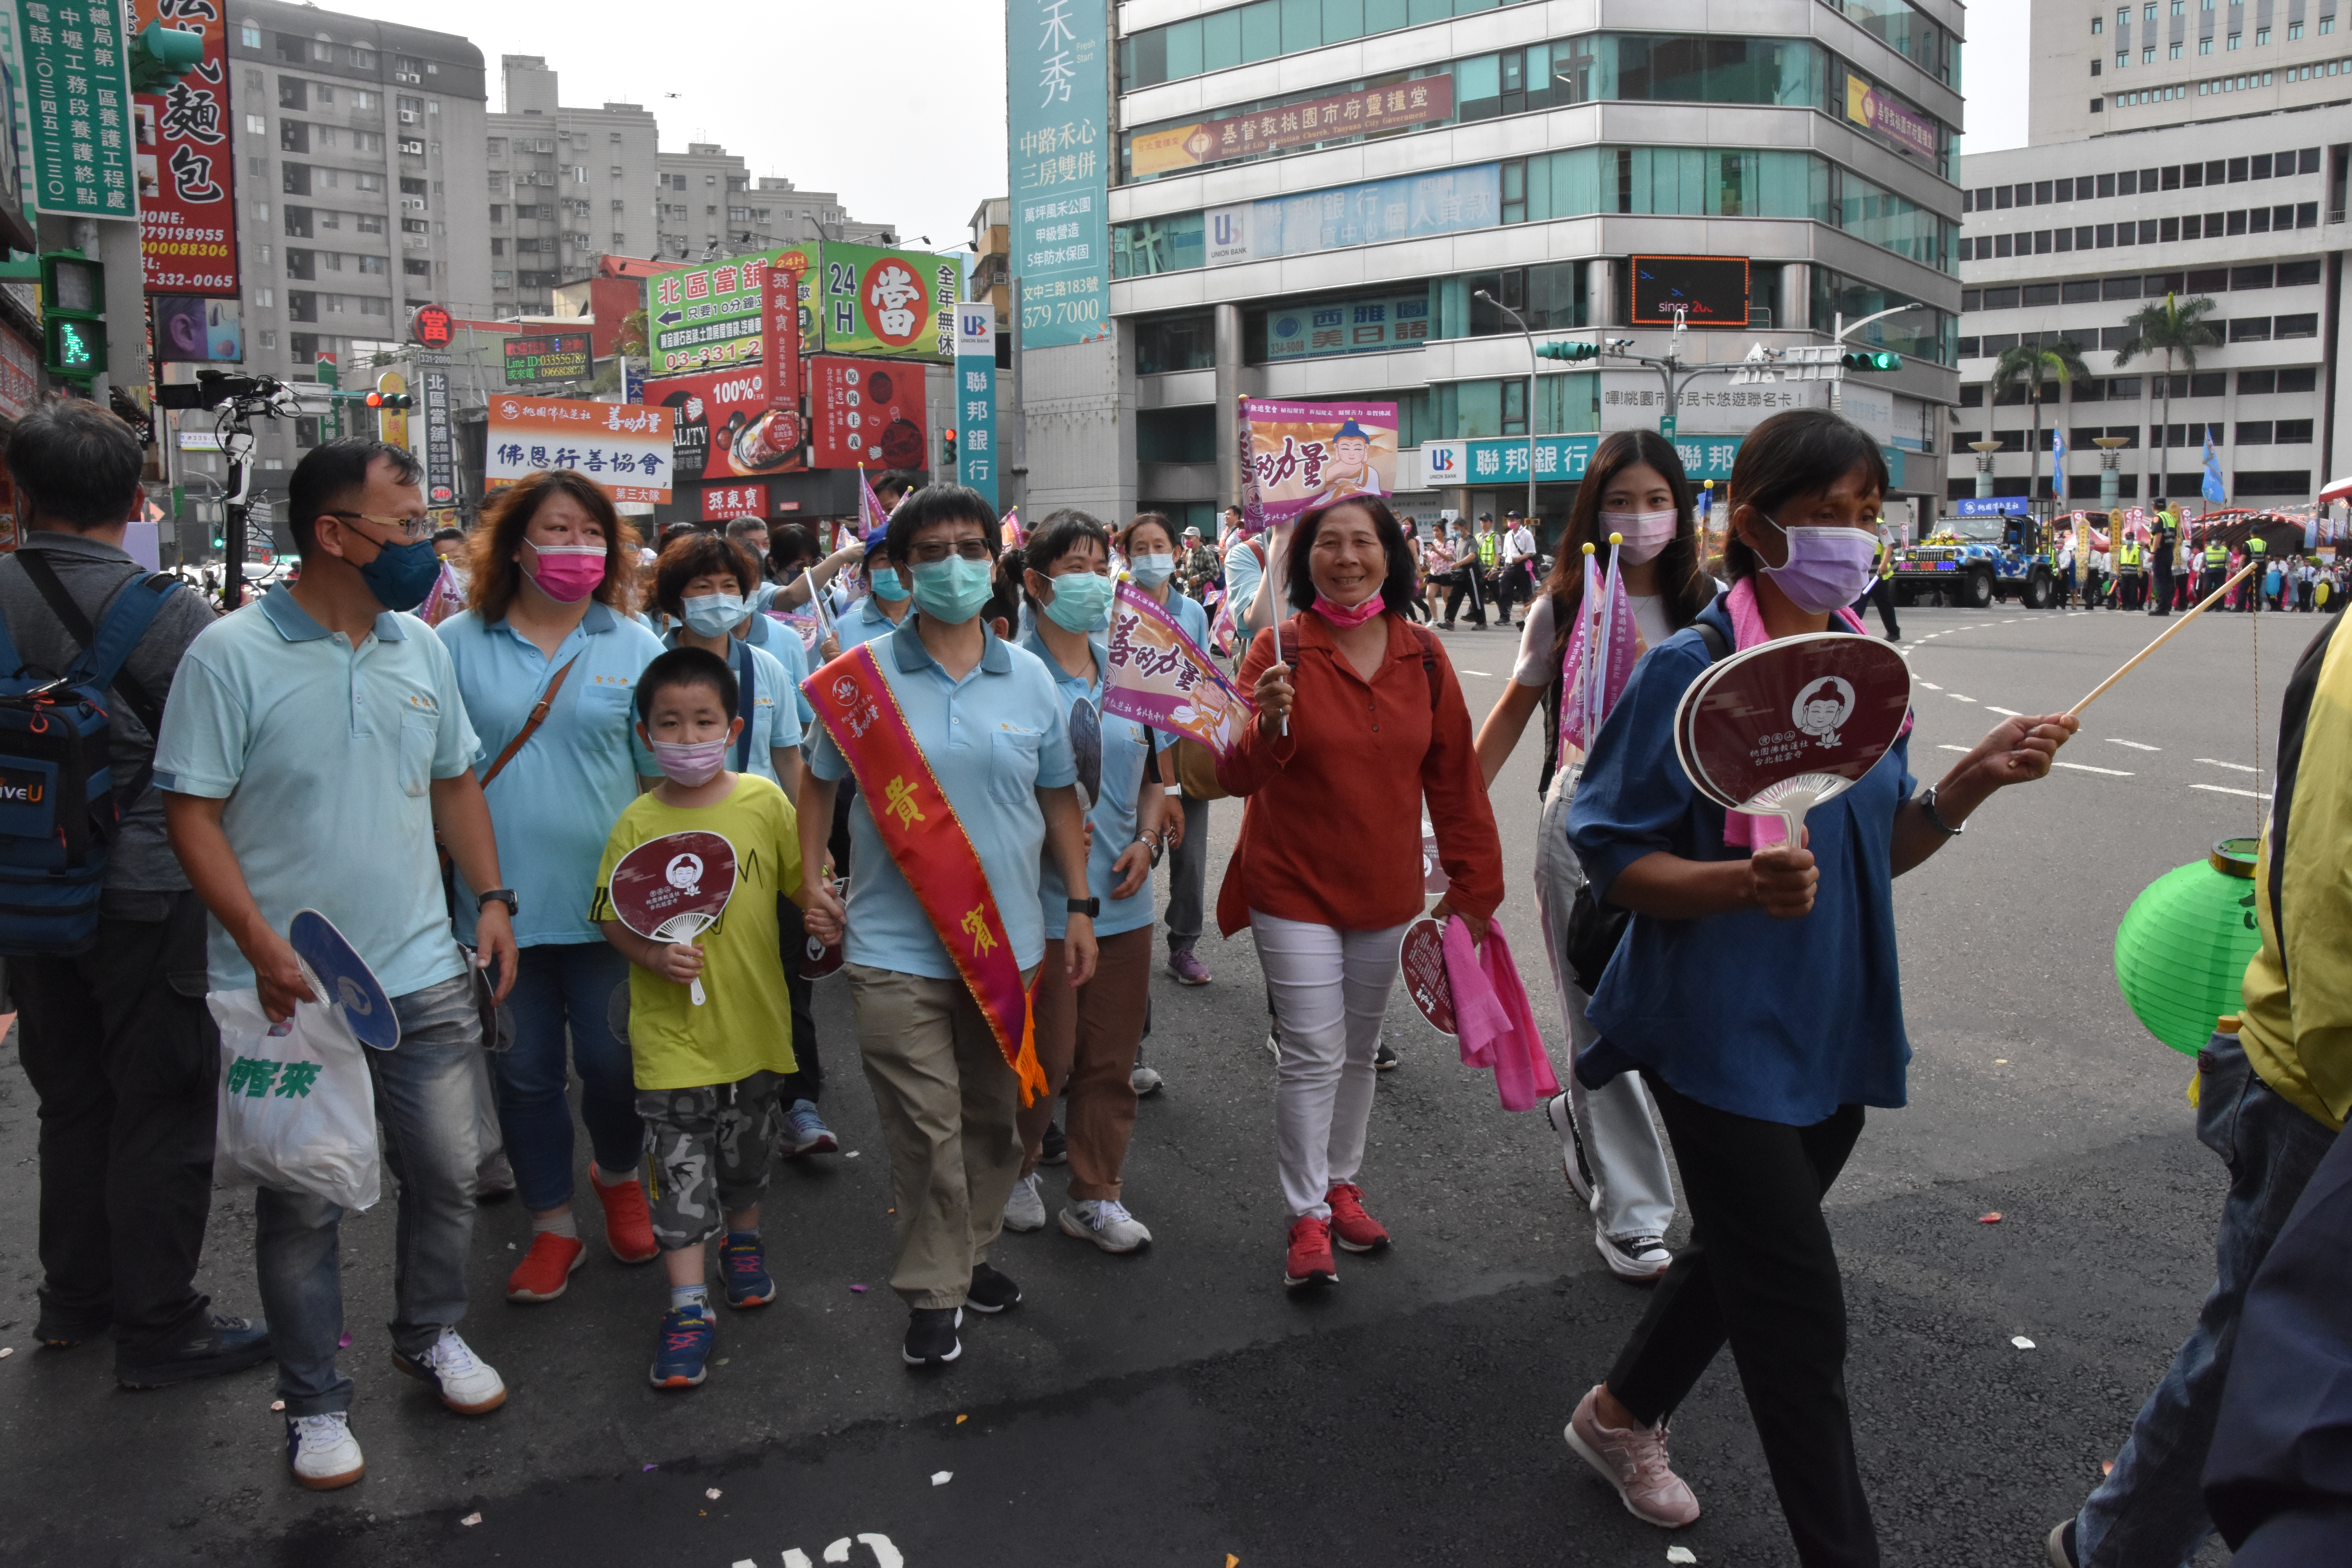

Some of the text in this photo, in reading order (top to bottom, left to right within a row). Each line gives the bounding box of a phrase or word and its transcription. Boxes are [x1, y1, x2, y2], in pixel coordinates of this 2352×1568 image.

[1077, 39, 1096, 51] Fresh
[1077, 52, 1093, 63] Start
[60, 7, 98, 205] 中壢工務段養護終點
[88, 0, 126, 208] 總局第一區養護工程處
[1221, 85, 1428, 145] 基督教桃園市府靈糧堂
[1020, 118, 1096, 157] 中路禾心
[1253, 140, 1266, 149] Life
[1365, 119, 1379, 127] City
[1383, 111, 1427, 124] Government
[1020, 150, 1096, 189] 三房雙併
[1024, 196, 1091, 223] 萬坪風禾公園
[1036, 222, 1079, 244] 甲級營造
[1027, 244, 1089, 267] 5年防水保固
[1211, 247, 1247, 258] UNION BANK
[829, 262, 857, 297] 24
[1023, 276, 1099, 302] 文中三路183號
[871, 266, 920, 337] 當
[936, 264, 956, 356] 全年無休
[1023, 298, 1099, 329] 379 7000
[1659, 301, 1688, 312] since
[421, 310, 448, 341] 當
[835, 300, 854, 334] H
[1312, 320, 1428, 348] 美日語
[420, 354, 451, 364] 331-2000
[506, 357, 525, 368] Line
[713, 378, 753, 404] 100%
[428, 374, 447, 442] 北區當舖
[602, 405, 661, 433] 善的力量
[848, 371, 859, 448] 原肉主義
[966, 372, 988, 481] 聯邦銀行
[497, 444, 665, 476] 佛恩行善協會
[1476, 445, 1588, 475] 聯邦銀行
[1675, 445, 1734, 471] 聯邦
[433, 488, 450, 499] 24H
[616, 488, 660, 501] 第三大隊
[1108, 614, 1202, 691] 善的力量
[1749, 740, 1809, 758] 桃園佛教蓮社
